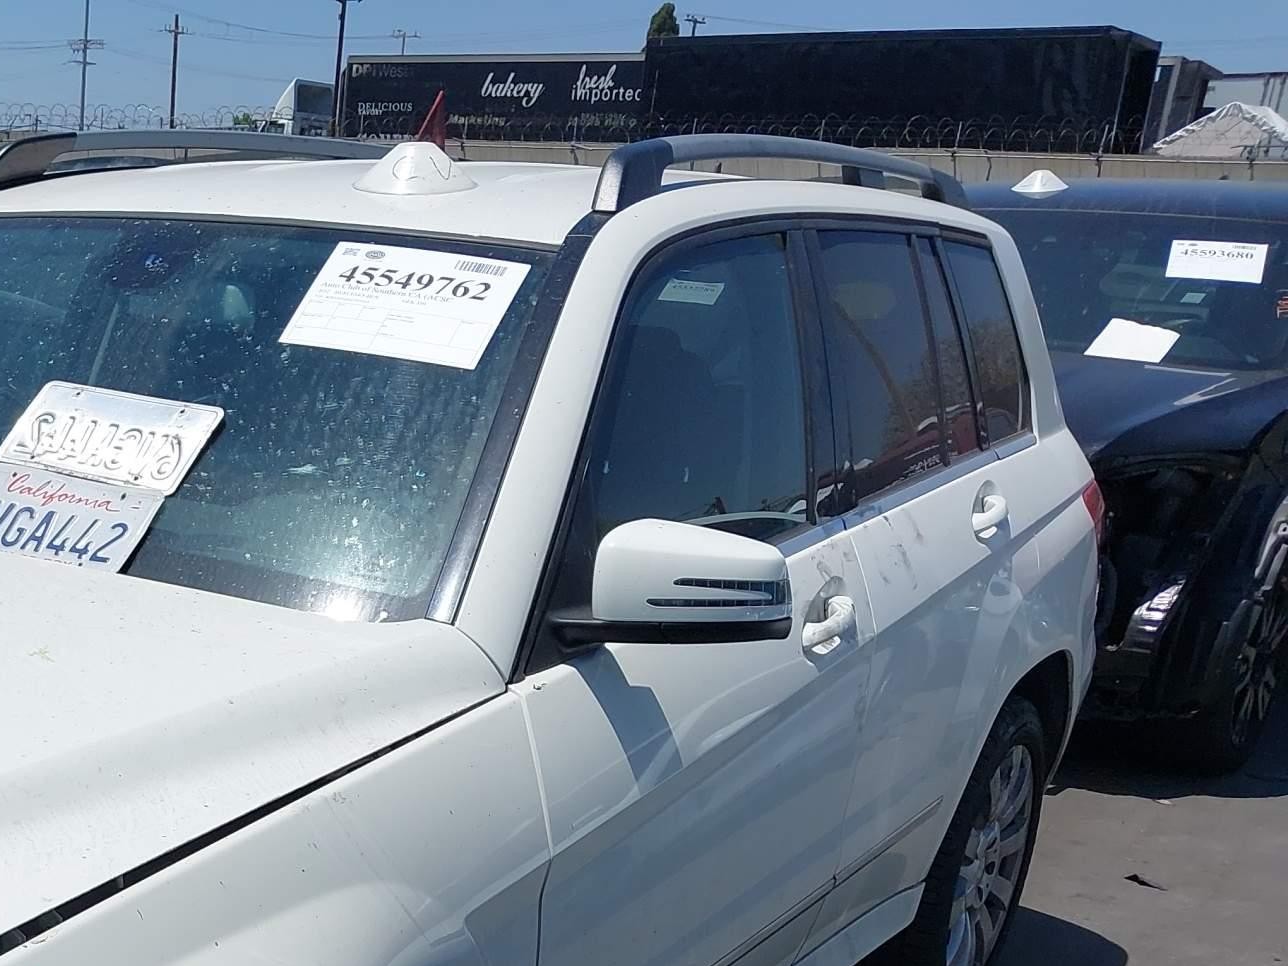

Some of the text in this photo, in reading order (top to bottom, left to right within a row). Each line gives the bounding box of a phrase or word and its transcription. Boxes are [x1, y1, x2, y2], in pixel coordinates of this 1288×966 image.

[481, 72, 545, 107] bakery
[576, 64, 617, 91] fresh
[358, 102, 413, 112] DELICIOUS
[1180, 248, 1254, 260] 45593680
[339, 265, 492, 301] 45549762
[7, 473, 120, 513] California
